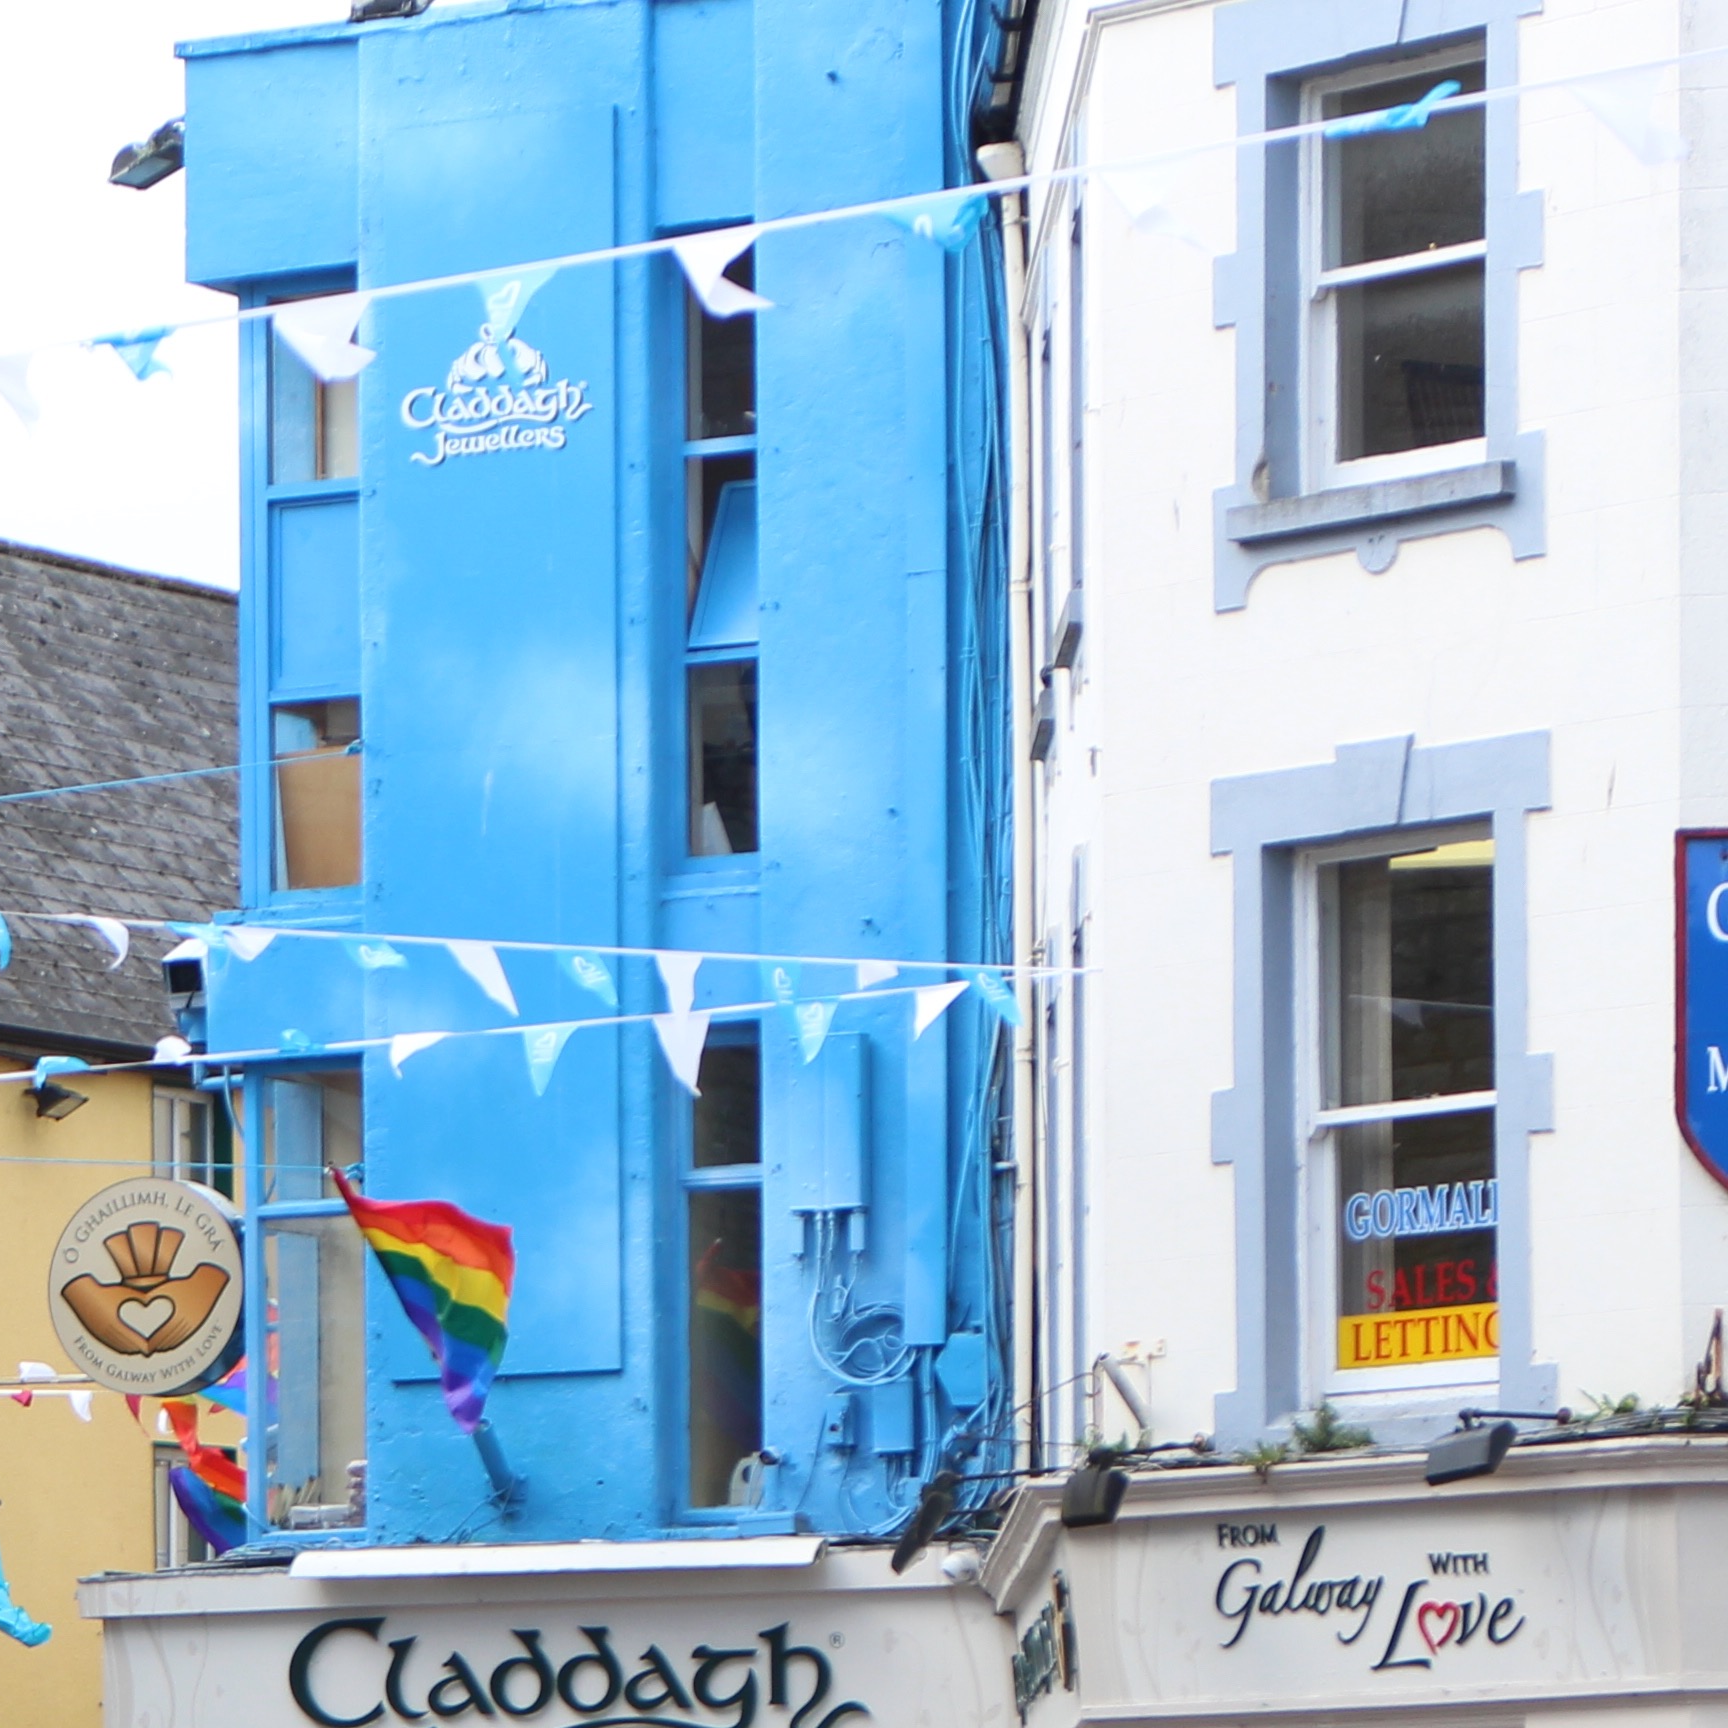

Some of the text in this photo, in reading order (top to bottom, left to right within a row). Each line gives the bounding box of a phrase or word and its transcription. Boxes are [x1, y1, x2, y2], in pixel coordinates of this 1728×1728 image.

[401, 379, 594, 435] Claddagh
[410, 422, 567, 467] Jewellers
[174, 1196, 192, 1217] LE
[1366, 1258, 1477, 1310] SALES
[74, 1321, 223, 1384] FROM GALWAY WITH LOVE
[1215, 1522, 1384, 1651] FROM Galway
[1428, 1551, 1490, 1576] WITH
